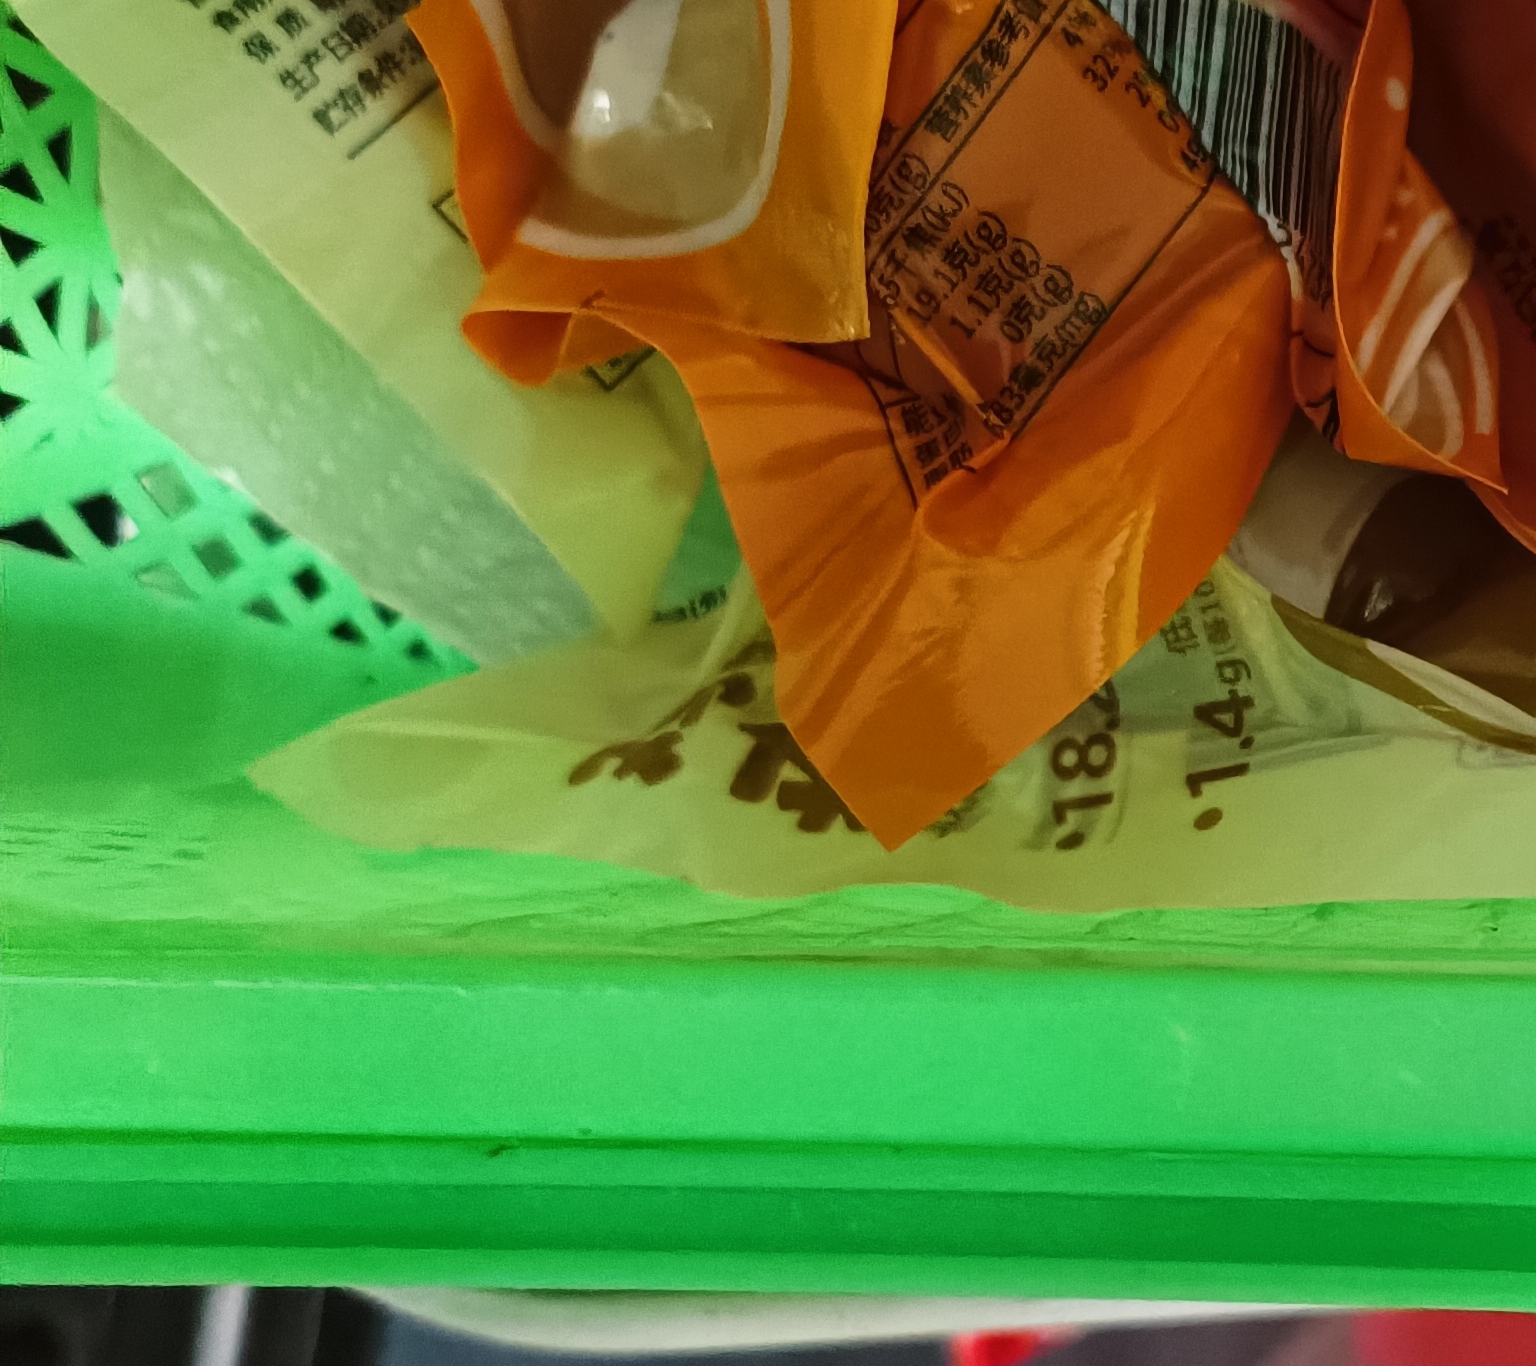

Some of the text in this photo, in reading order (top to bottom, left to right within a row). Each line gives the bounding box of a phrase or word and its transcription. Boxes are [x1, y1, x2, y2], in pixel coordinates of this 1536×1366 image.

[896, 210, 1008, 329] 19.1克(g)
[942, 236, 1041, 346] 1.1克(g)
[999, 263, 1075, 347] 0克(g)
